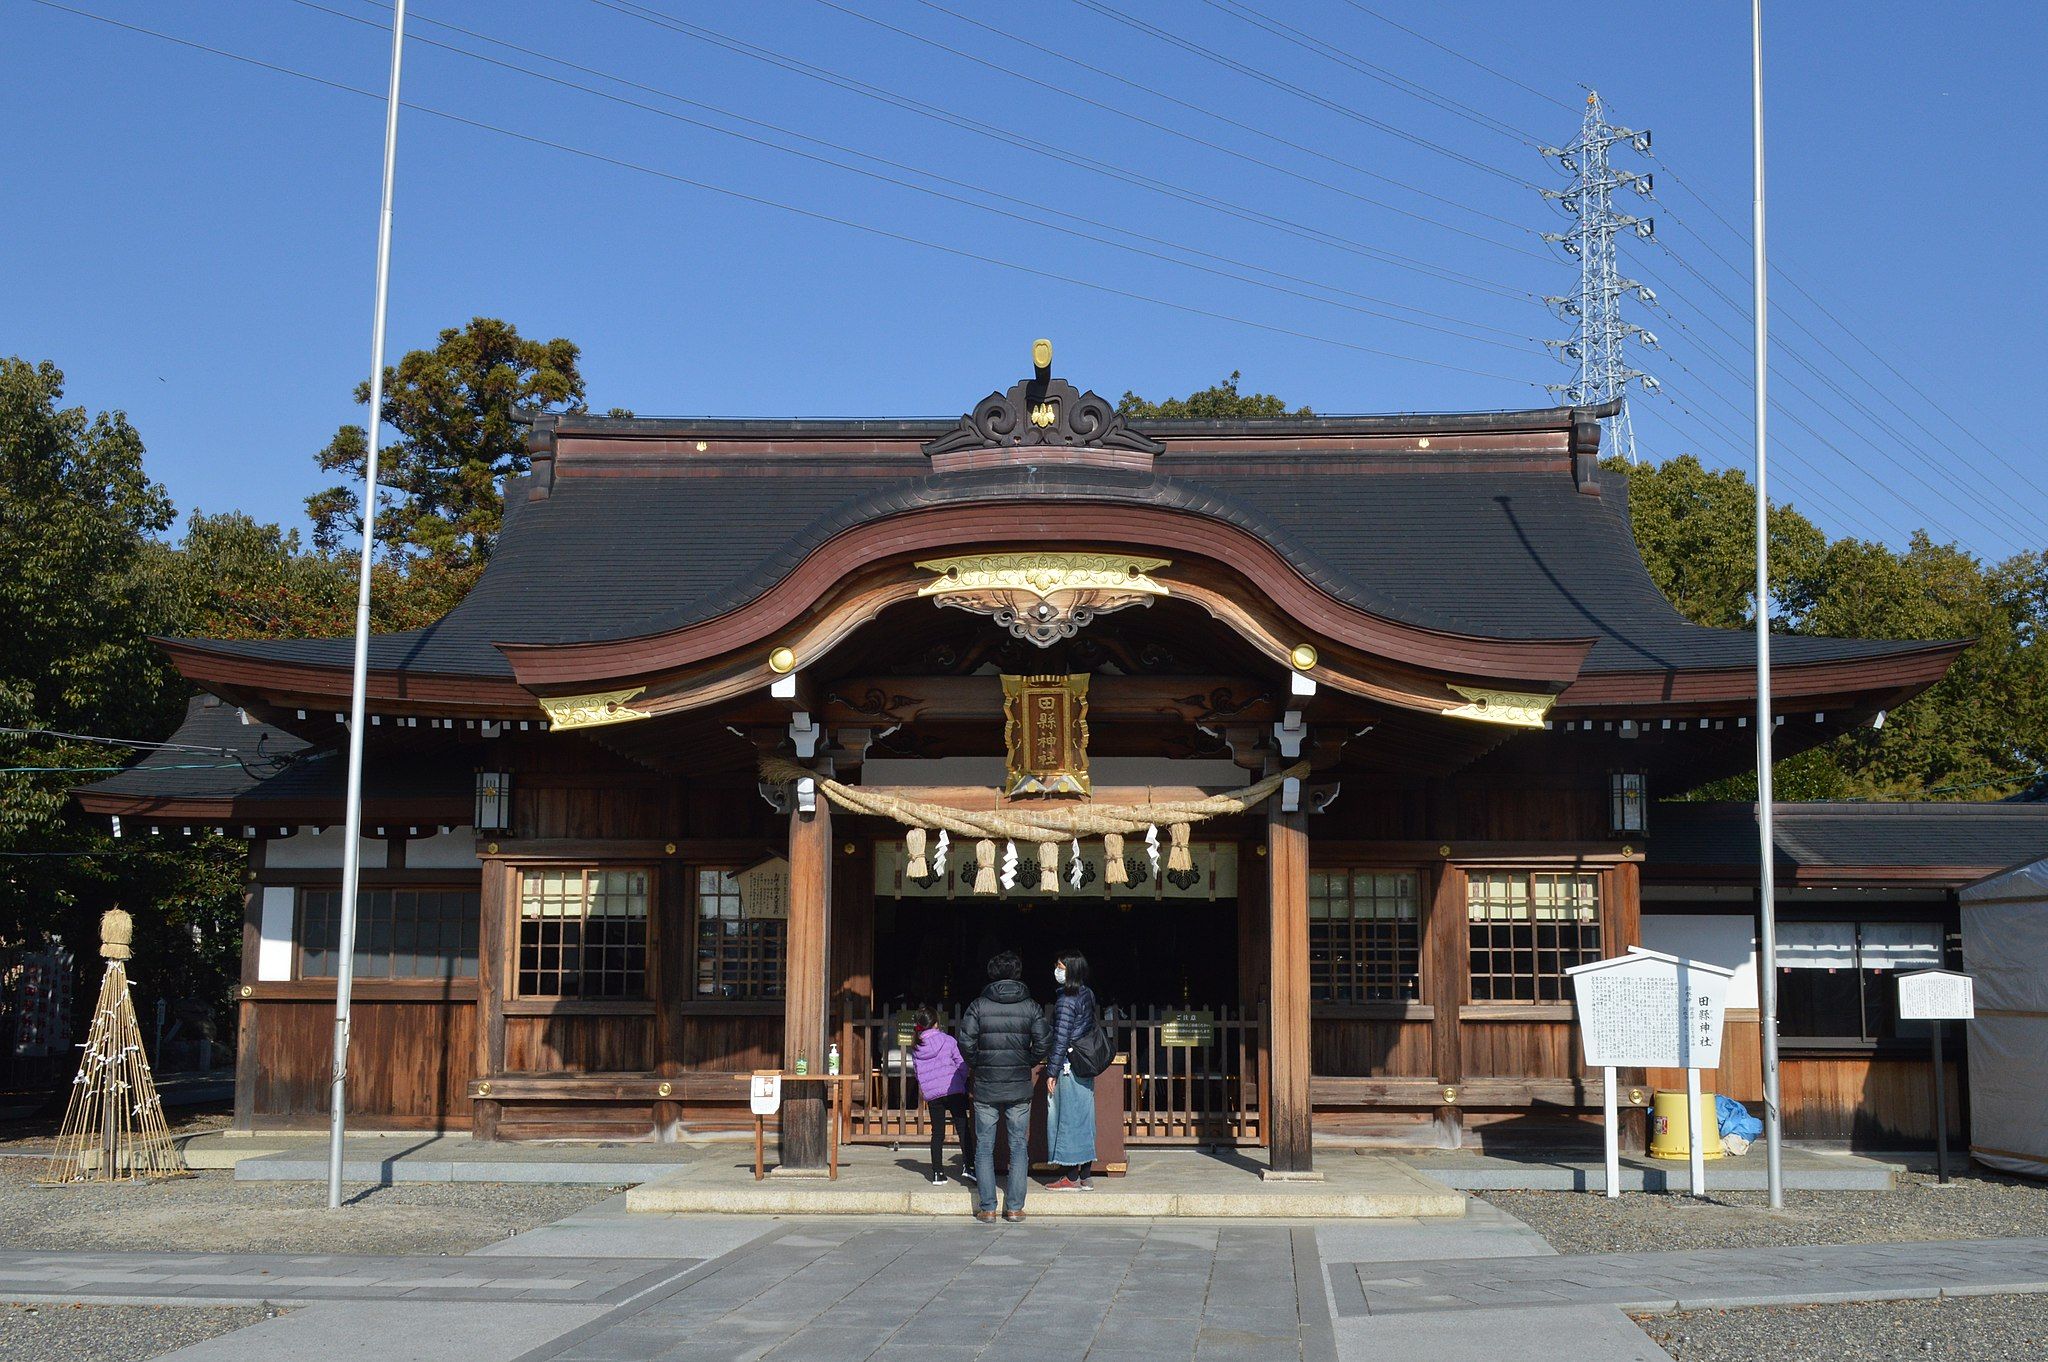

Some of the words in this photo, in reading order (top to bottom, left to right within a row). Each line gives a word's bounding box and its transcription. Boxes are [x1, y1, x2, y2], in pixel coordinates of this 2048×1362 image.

[1037, 697, 1057, 765] 田縣神社
[1698, 996, 1712, 1047] 田縣神社
